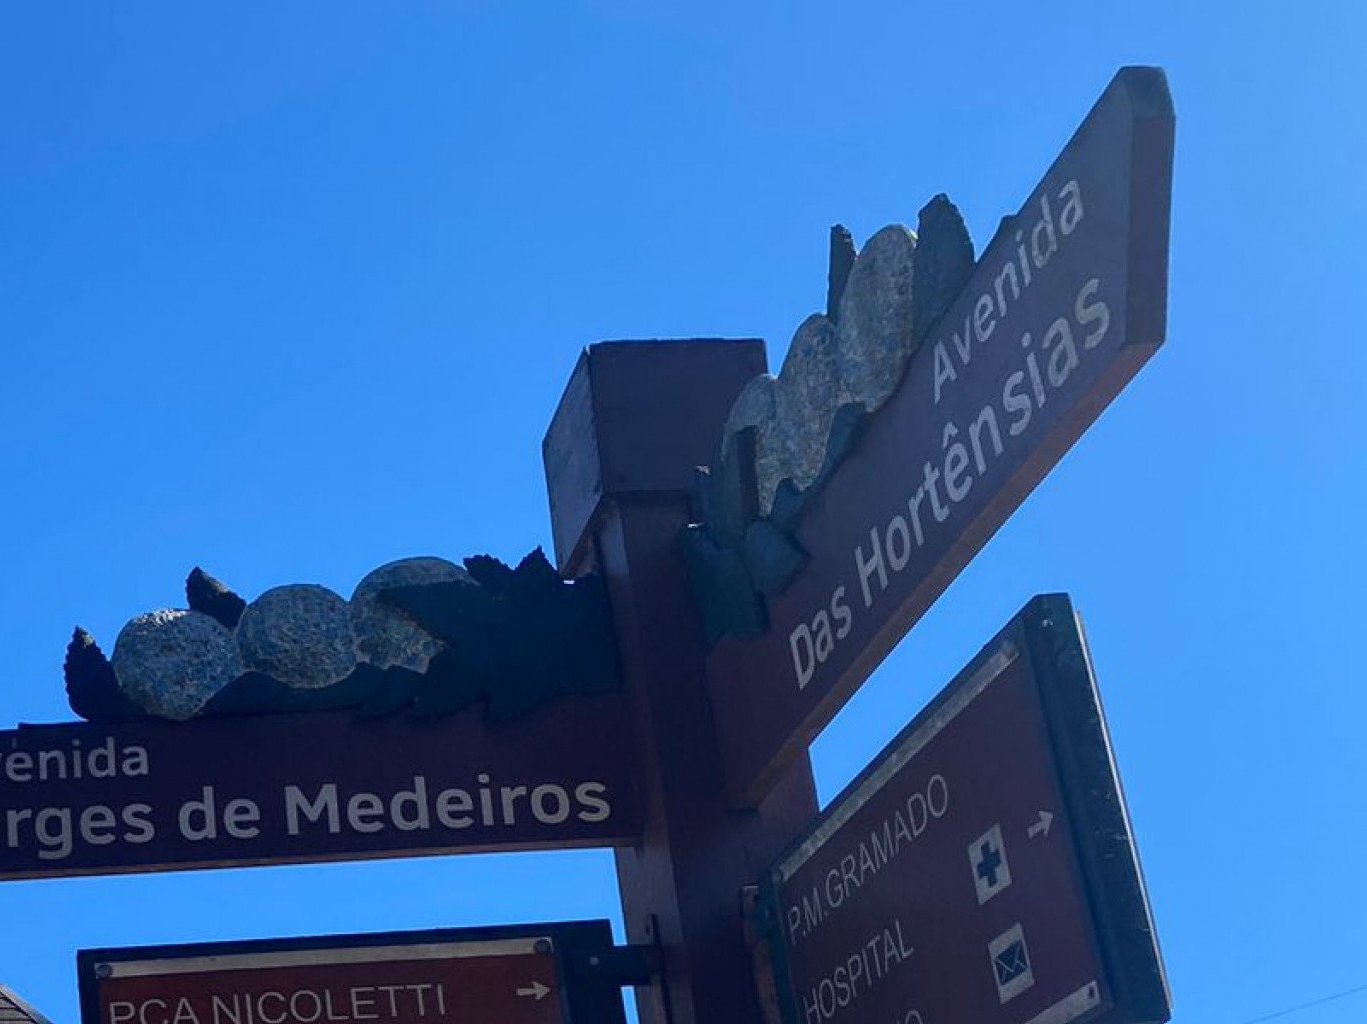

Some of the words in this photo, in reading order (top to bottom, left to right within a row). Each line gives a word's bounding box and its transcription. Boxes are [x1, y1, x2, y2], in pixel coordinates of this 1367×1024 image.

[935, 179, 1085, 403] Avenida
[790, 588, 852, 690] Das
[855, 277, 1112, 607] Hortênsias
[178, 787, 260, 840] de
[286, 774, 612, 836] Medeiros
